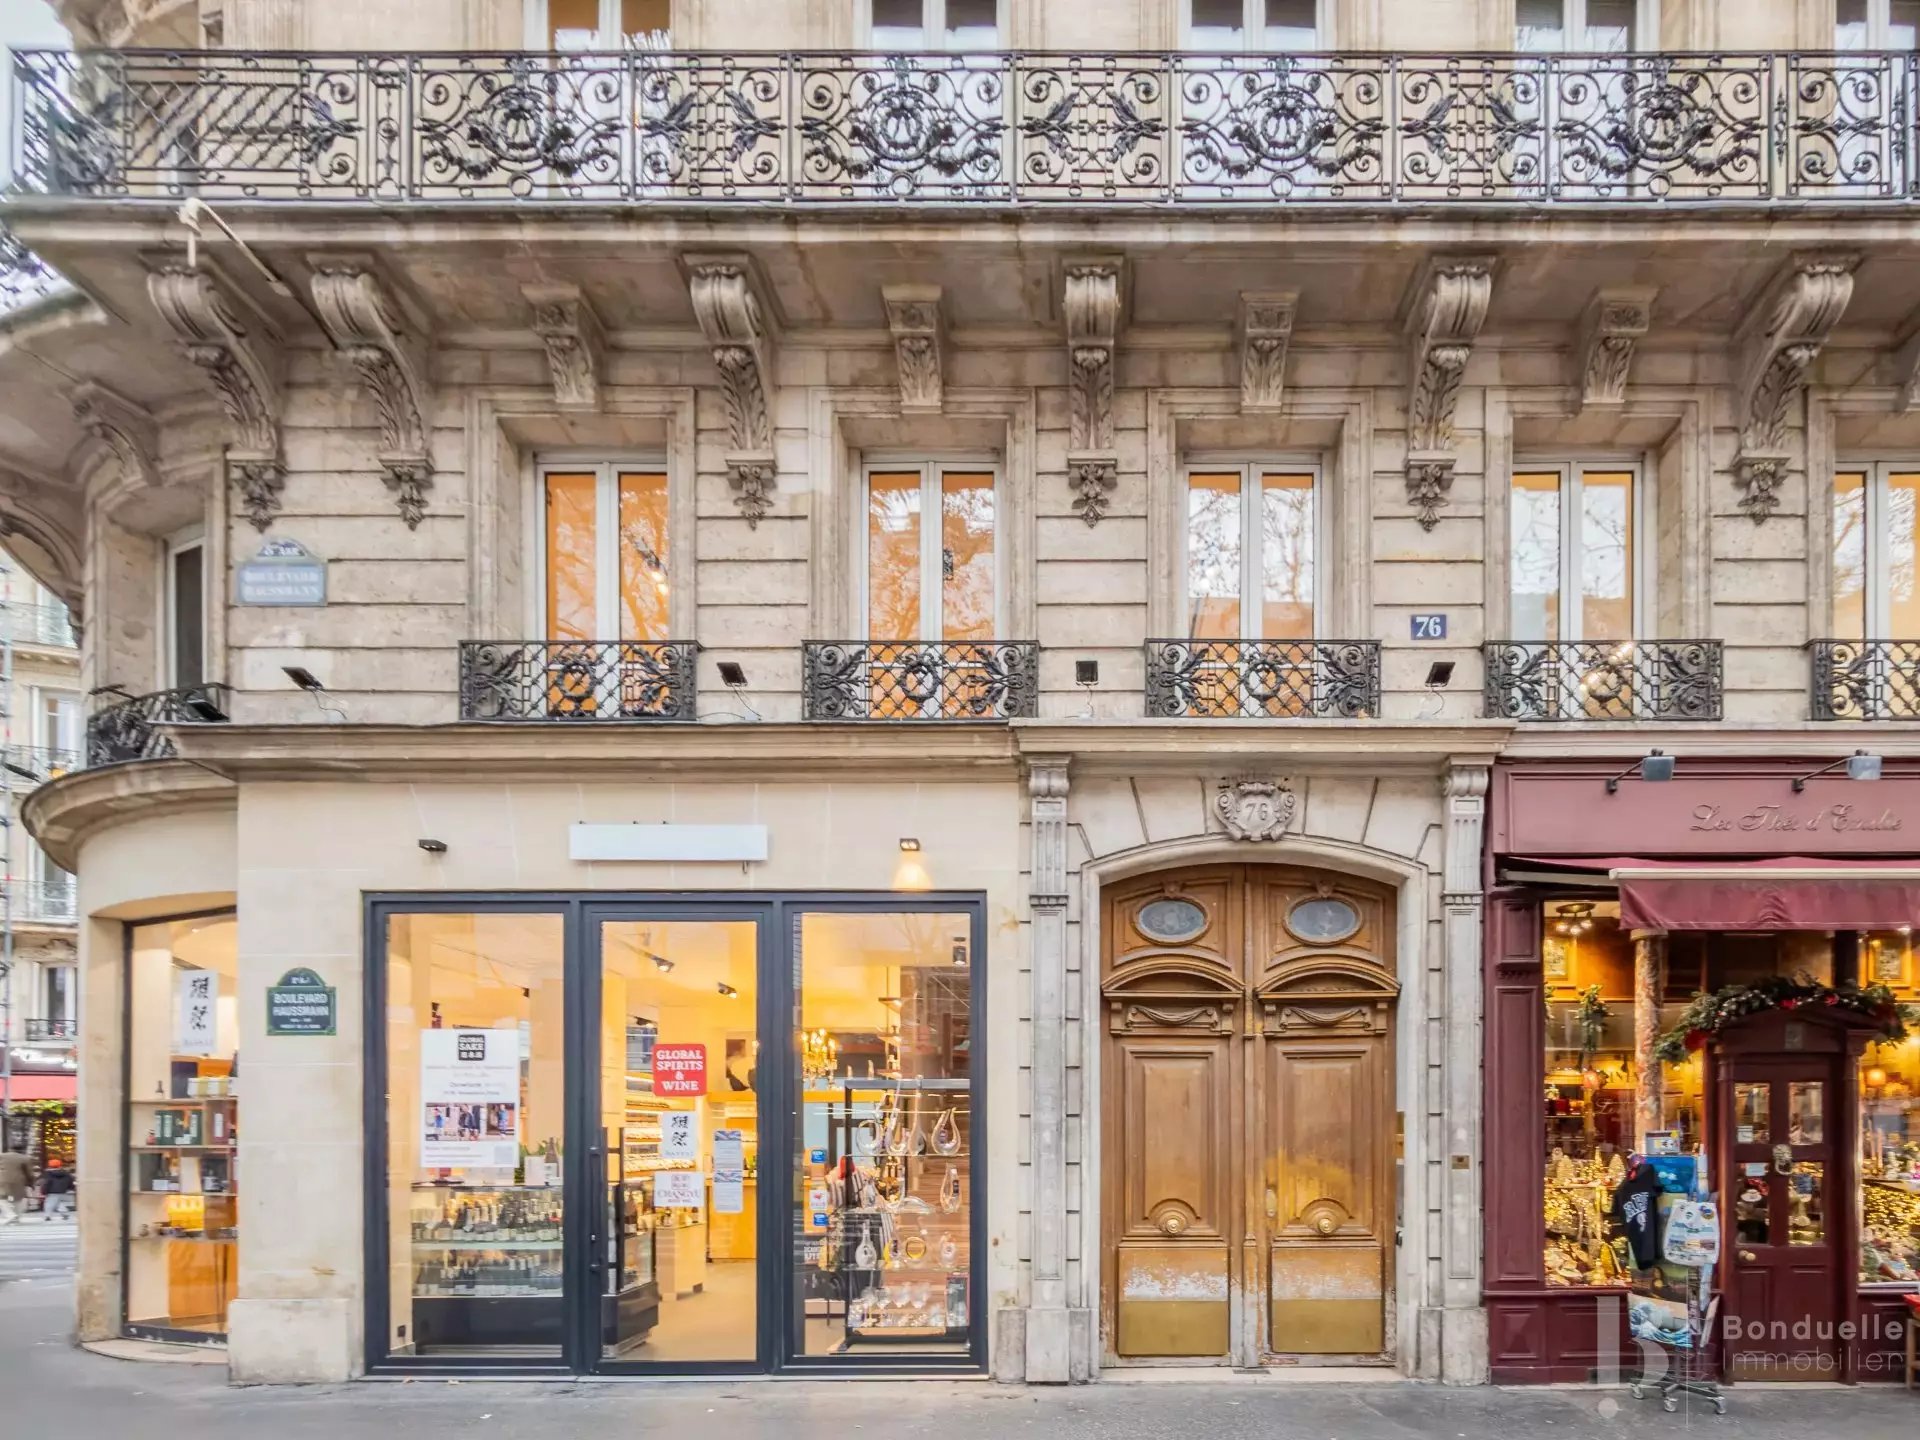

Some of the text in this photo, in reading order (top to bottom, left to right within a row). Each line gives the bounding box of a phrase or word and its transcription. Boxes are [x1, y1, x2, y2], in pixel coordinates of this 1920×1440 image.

[1415, 616, 1442, 637] 76
[1245, 802, 1270, 821] 76
[273, 993, 329, 1004] BOULEVARD
[272, 1005, 329, 1016] HAUSSMANN
[459, 1043, 484, 1051] SAKE
[656, 1050, 704, 1060] GLOBAL
[656, 1060, 704, 1071] SPIRITS
[674, 1070, 685, 1081] &
[661, 1080, 700, 1091] WINE
